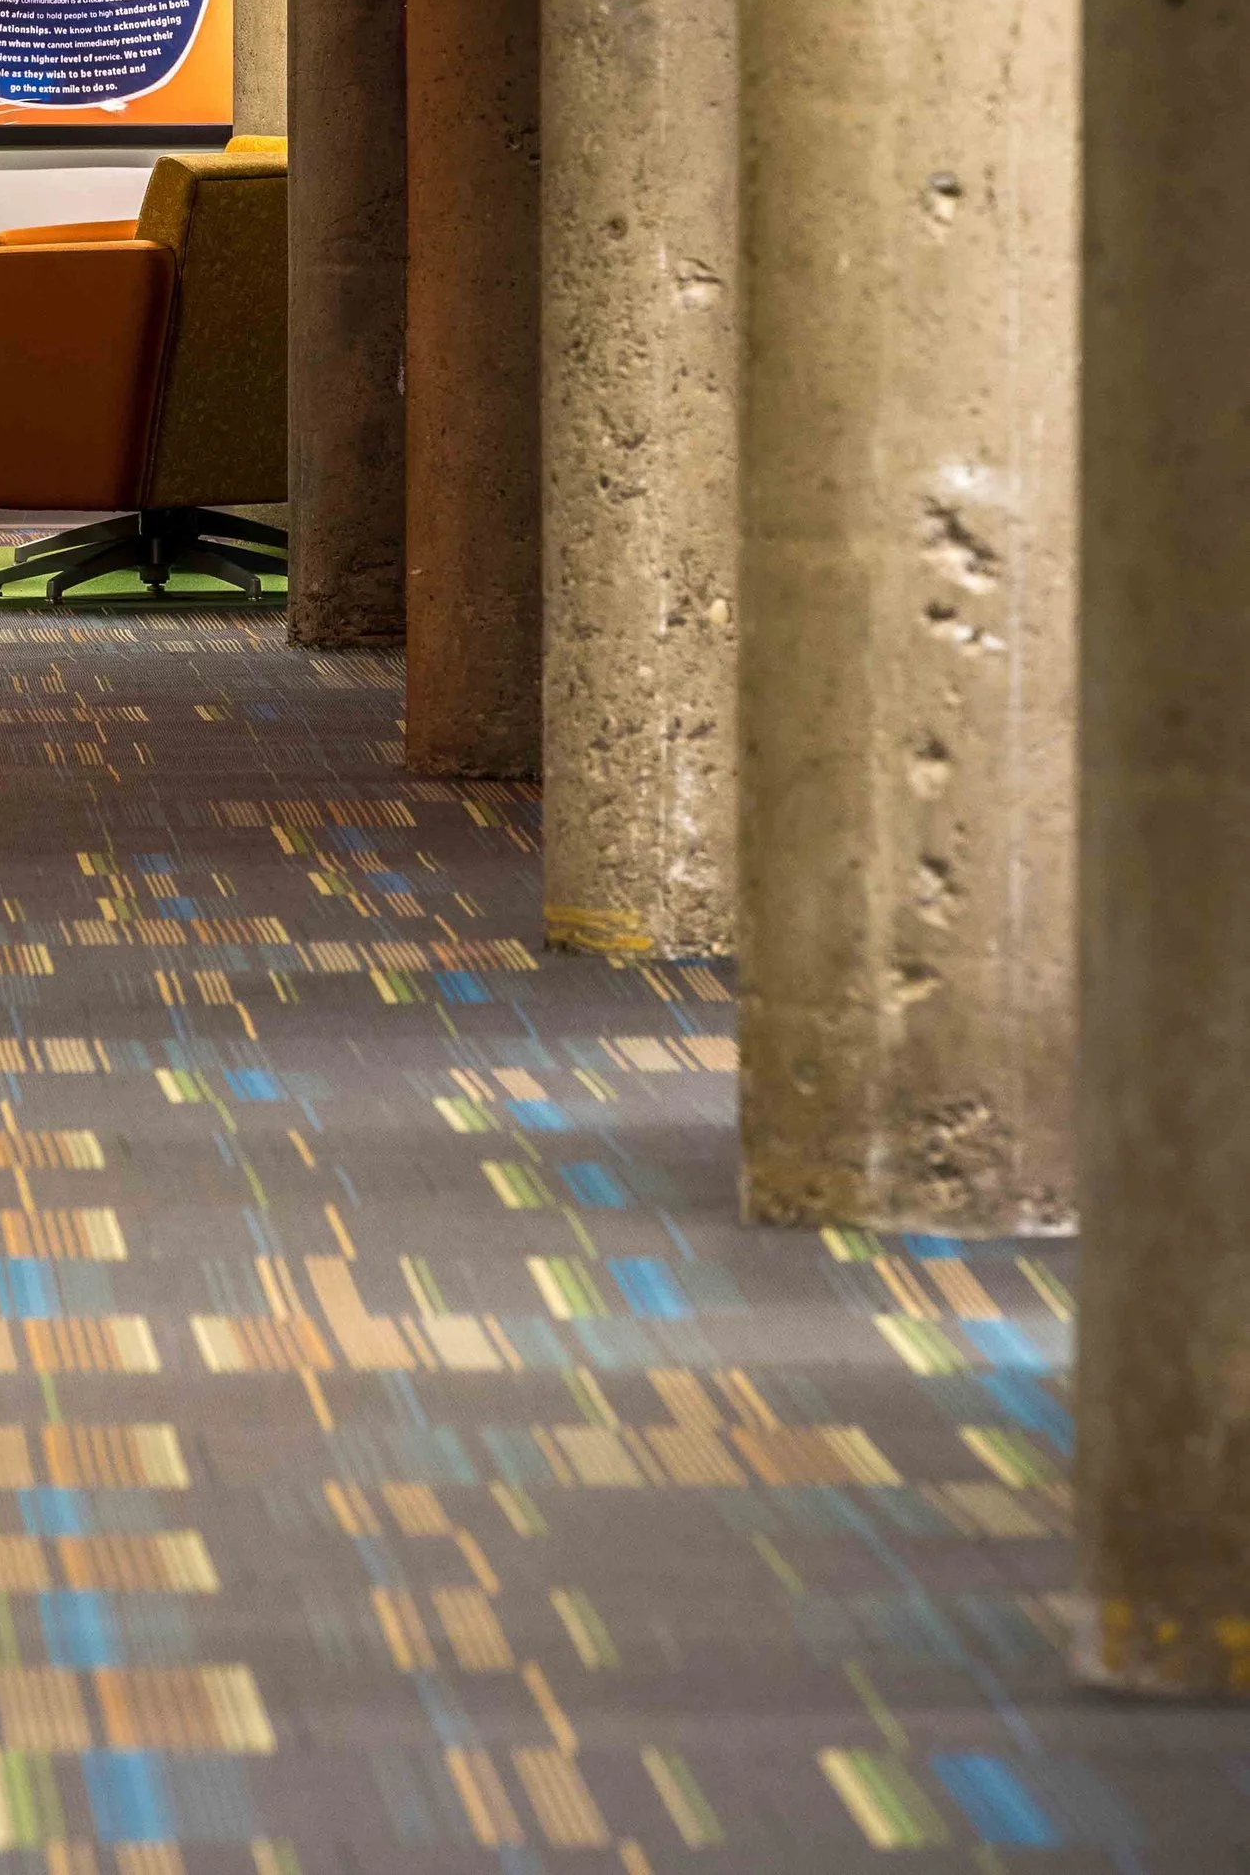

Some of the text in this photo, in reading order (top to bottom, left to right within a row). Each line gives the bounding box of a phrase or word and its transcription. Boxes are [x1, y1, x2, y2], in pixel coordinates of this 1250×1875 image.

[11, 11, 35, 19] afraid
[46, 12, 62, 20] hold
[63, 12, 88, 20] people
[98, 9, 114, 18] high
[114, 3, 158, 13] standards
[158, 2, 168, 11] in
[53, 27, 67, 35] We
[69, 26, 92, 34] know
[93, 24, 111, 33] that
[113, 16, 182, 31] acknowledging
[7, 39, 31, 48] when
[74, 38, 120, 48] immediately
[121, 34, 152, 44] resolve
[152, 30, 173, 41] their
[30, 54, 59, 65] higher
[60, 54, 82, 63] level
[82, 53, 93, 63] of
[93, 53, 122, 62] service.
[123, 50, 138, 59] We
[139, 47, 161, 57] treat
[23, 69, 44, 80] they
[45, 70, 67, 79] wish
[68, 70, 79, 79] to
[80, 69, 92, 78] be
[93, 65, 128, 77] treated
[129, 63, 146, 74] and
[10, 83, 117, 94] go the extra mile to do so.
